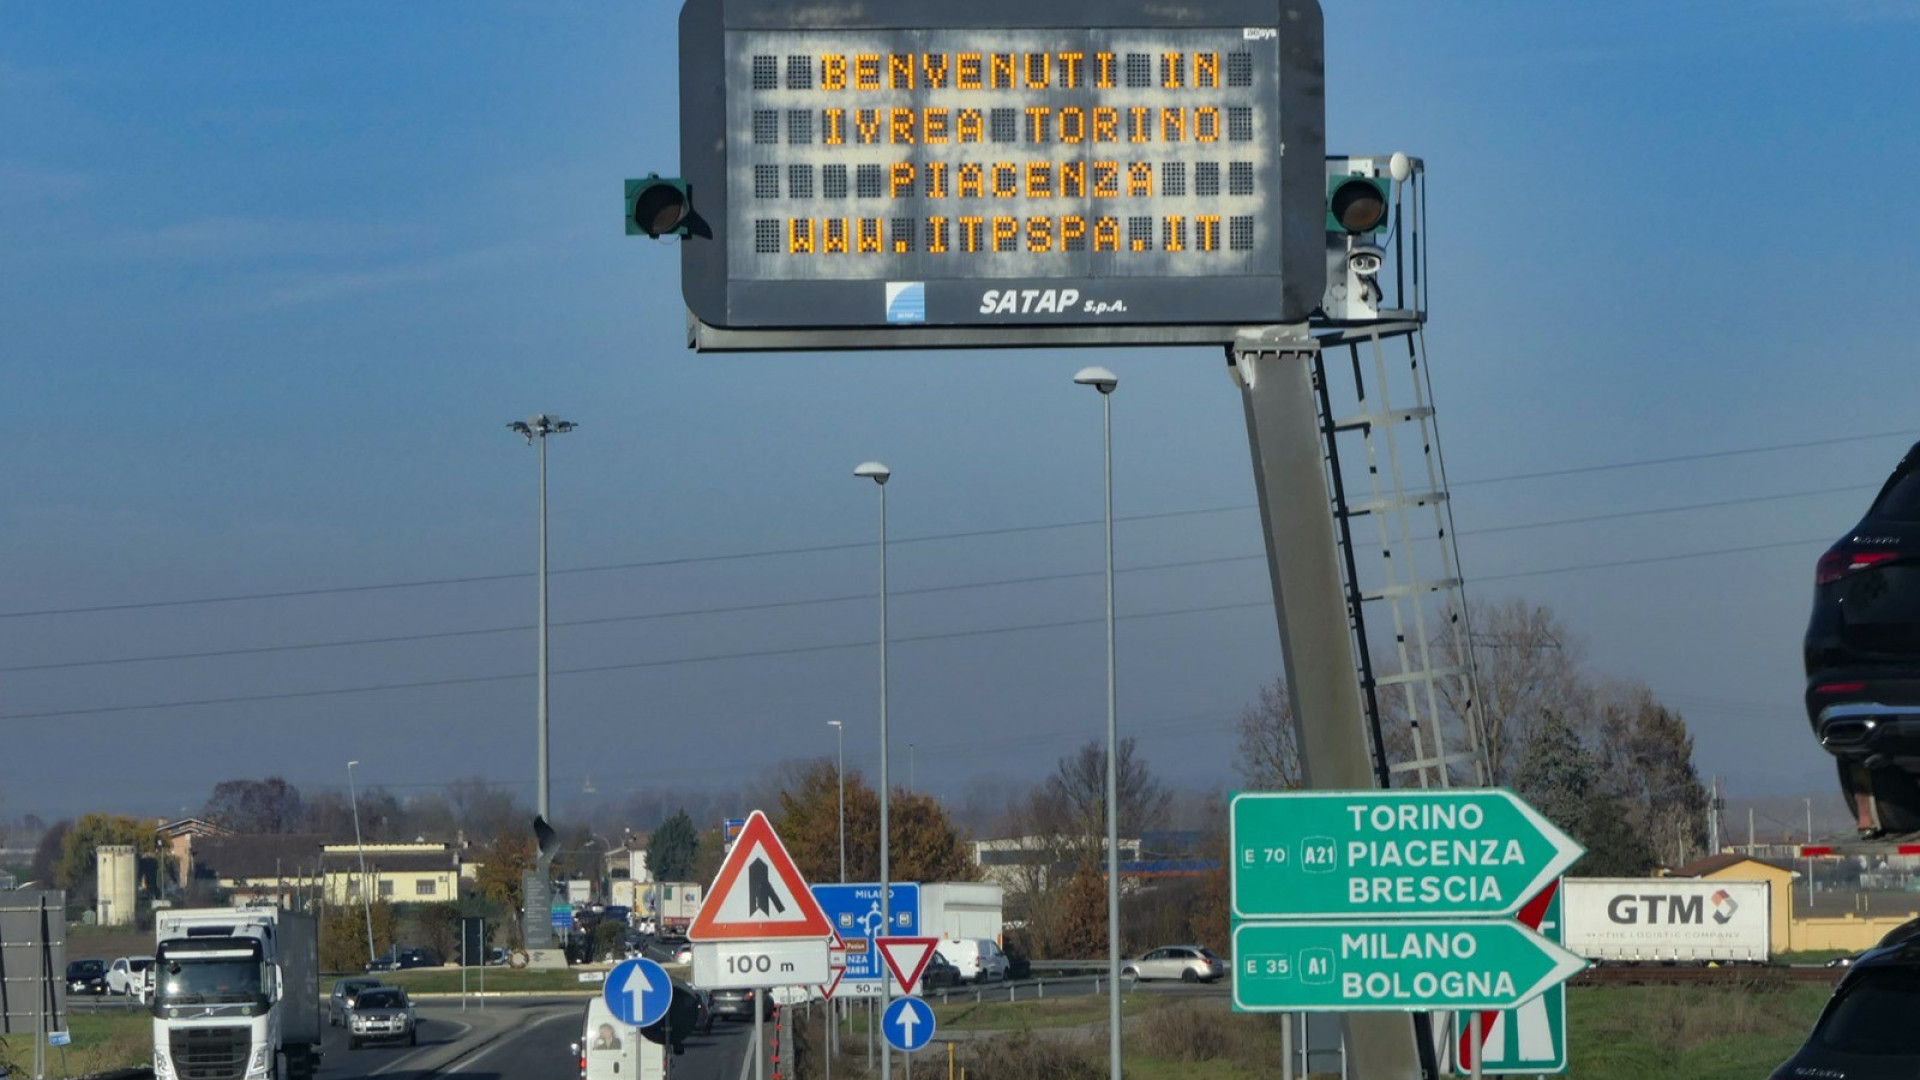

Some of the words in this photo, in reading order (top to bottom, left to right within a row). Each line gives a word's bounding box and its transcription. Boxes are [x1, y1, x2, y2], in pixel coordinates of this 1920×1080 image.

[821, 53, 1113, 90] BENVENUTI
[1163, 52, 1219, 89] IN
[826, 107, 983, 145] IVREA
[1025, 107, 1219, 143] TORINO
[889, 161, 1152, 198] PIACENZA
[788, 215, 1220, 254] WWW.ITPSPA.IT
[979, 289, 1079, 314] SATAP
[1347, 804, 1484, 831] TORINO
[1245, 848, 1254, 863] E
[1263, 848, 1286, 863] 70
[1304, 846, 1334, 865] A21
[1348, 839, 1525, 868] PIACENZA
[1348, 875, 1502, 904] BRESCIA
[1607, 894, 1704, 925] GTM
[1341, 932, 1477, 960] MILANO
[1630, 931, 1681, 939] LOGISTIC
[1685, 930, 1740, 939] COMPANY
[726, 955, 771, 974] 100
[780, 962, 795, 972] m
[1247, 959, 1257, 974] E
[1267, 959, 1288, 974] 35
[1308, 957, 1327, 975] A1
[856, 984, 870, 993] 50
[1342, 970, 1517, 999] BOLOGNA
